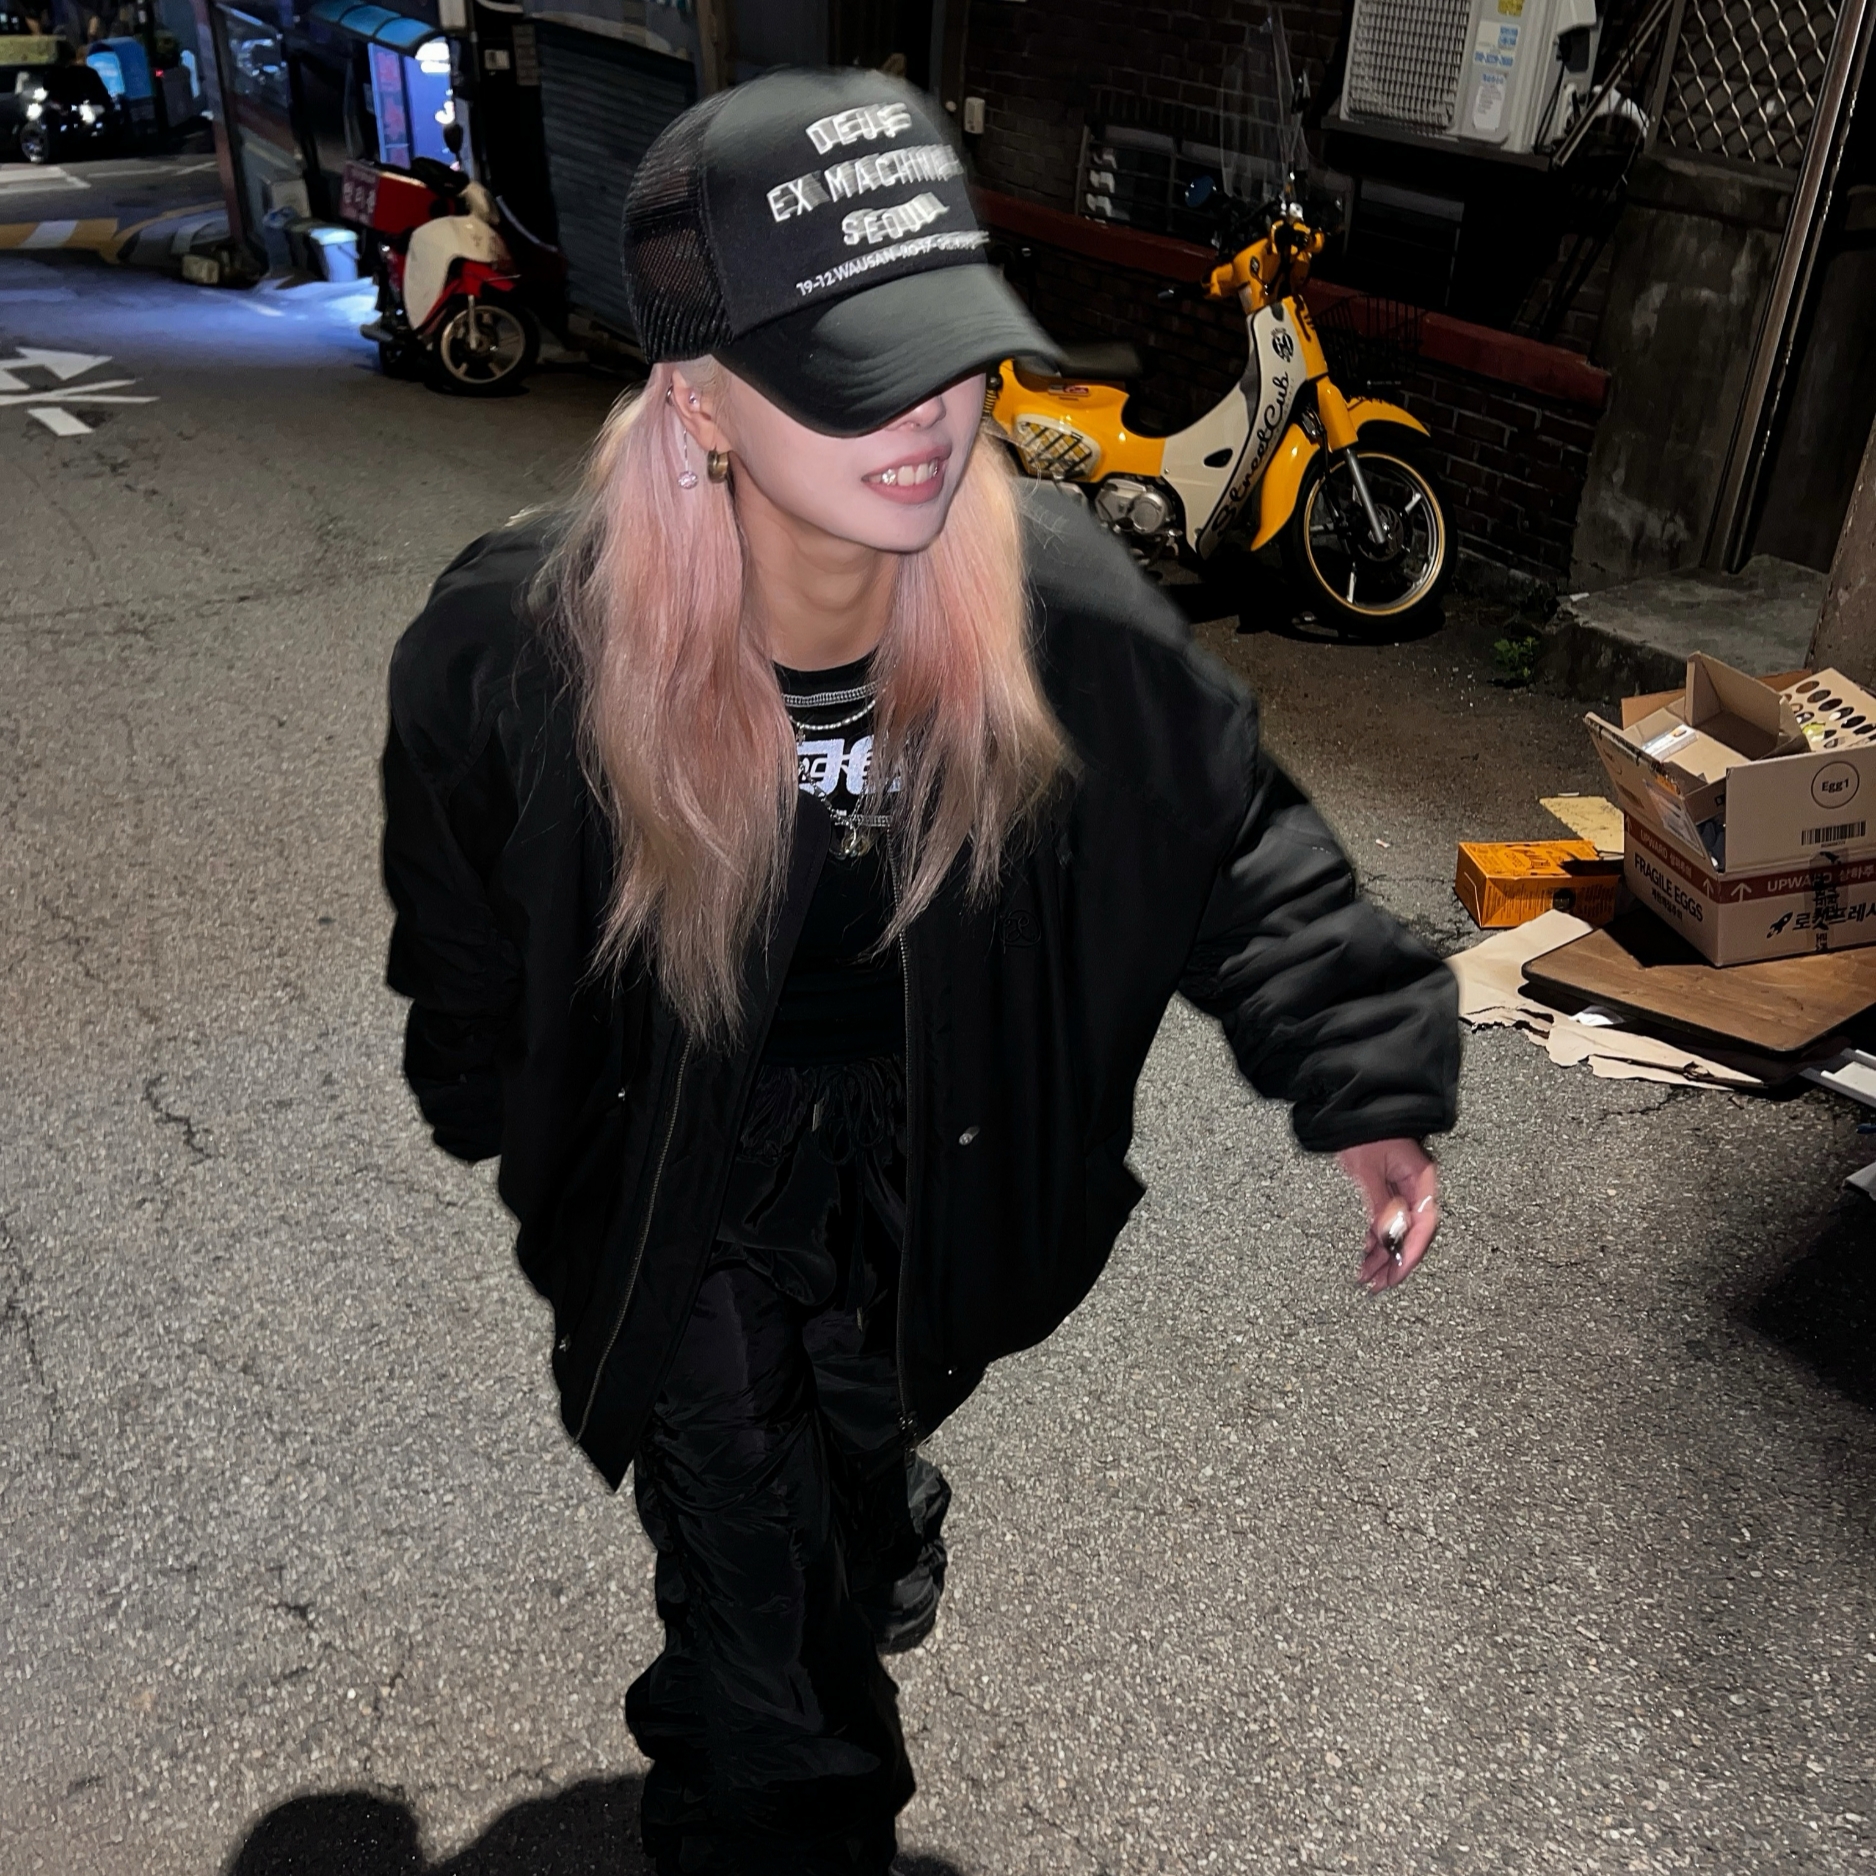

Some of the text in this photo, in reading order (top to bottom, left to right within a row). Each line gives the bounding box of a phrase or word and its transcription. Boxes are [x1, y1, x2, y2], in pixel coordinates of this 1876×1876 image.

[806, 102, 911, 154] DEUS
[767, 172, 826, 223] EX
[842, 192, 949, 245] SEOUL
[1634, 852, 1673, 898] FRAGILE
[1674, 885, 1704, 922] EGGS
[1767, 872, 1833, 892] UPWAD
